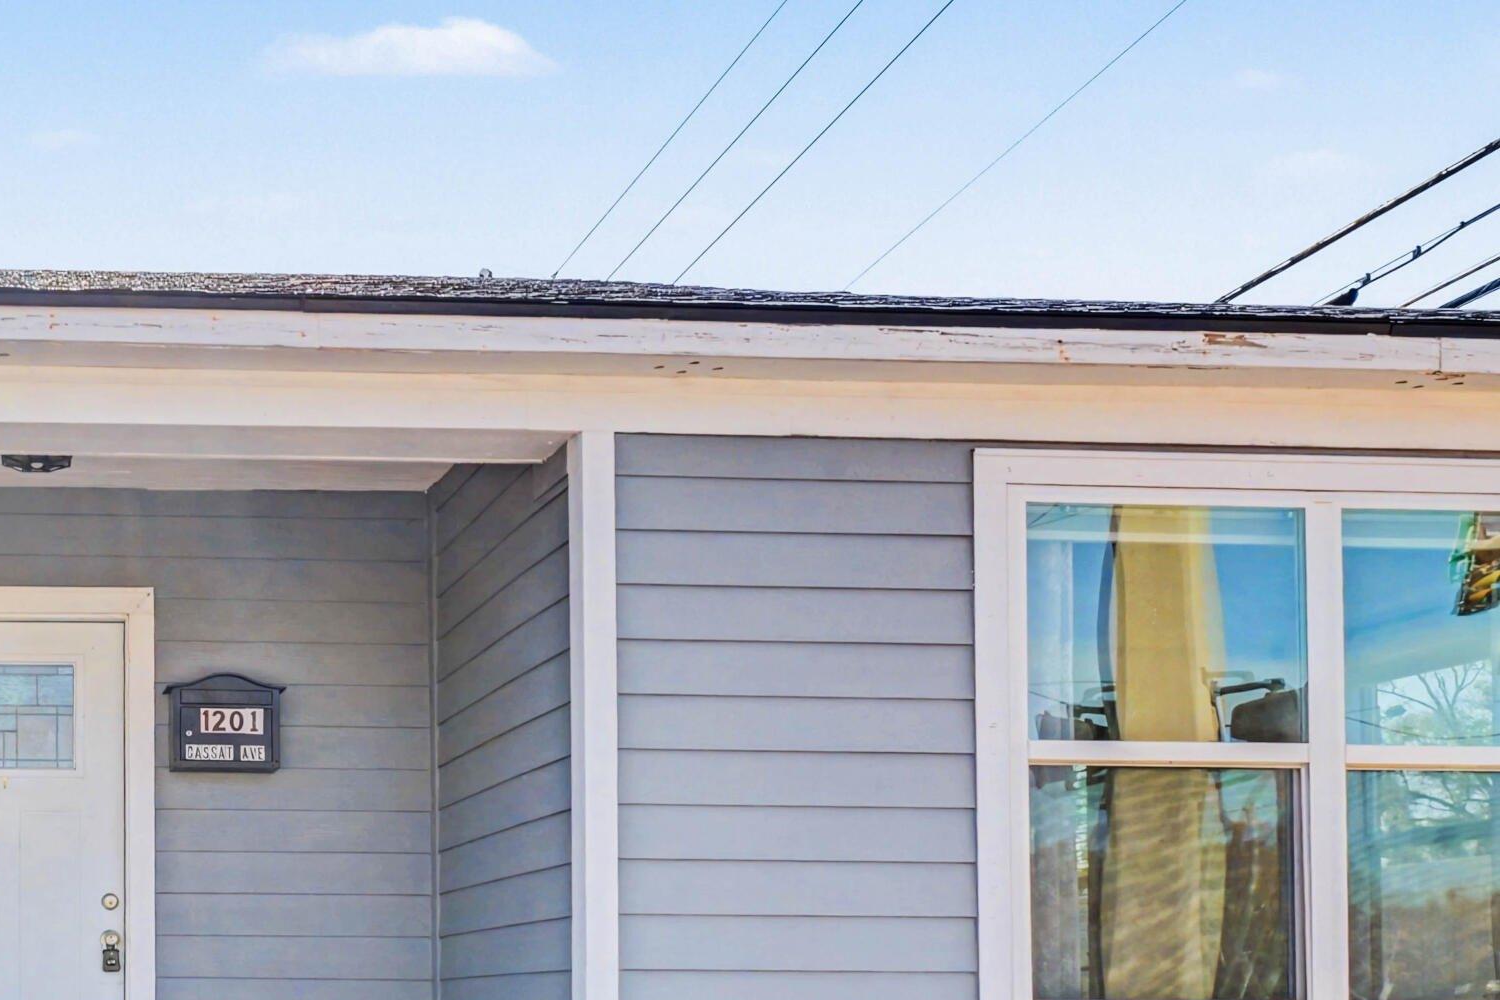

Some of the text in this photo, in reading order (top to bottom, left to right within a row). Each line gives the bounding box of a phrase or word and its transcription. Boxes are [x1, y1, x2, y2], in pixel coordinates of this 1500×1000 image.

[202, 709, 259, 732] 1201
[186, 745, 264, 760] CASSAT AVE
